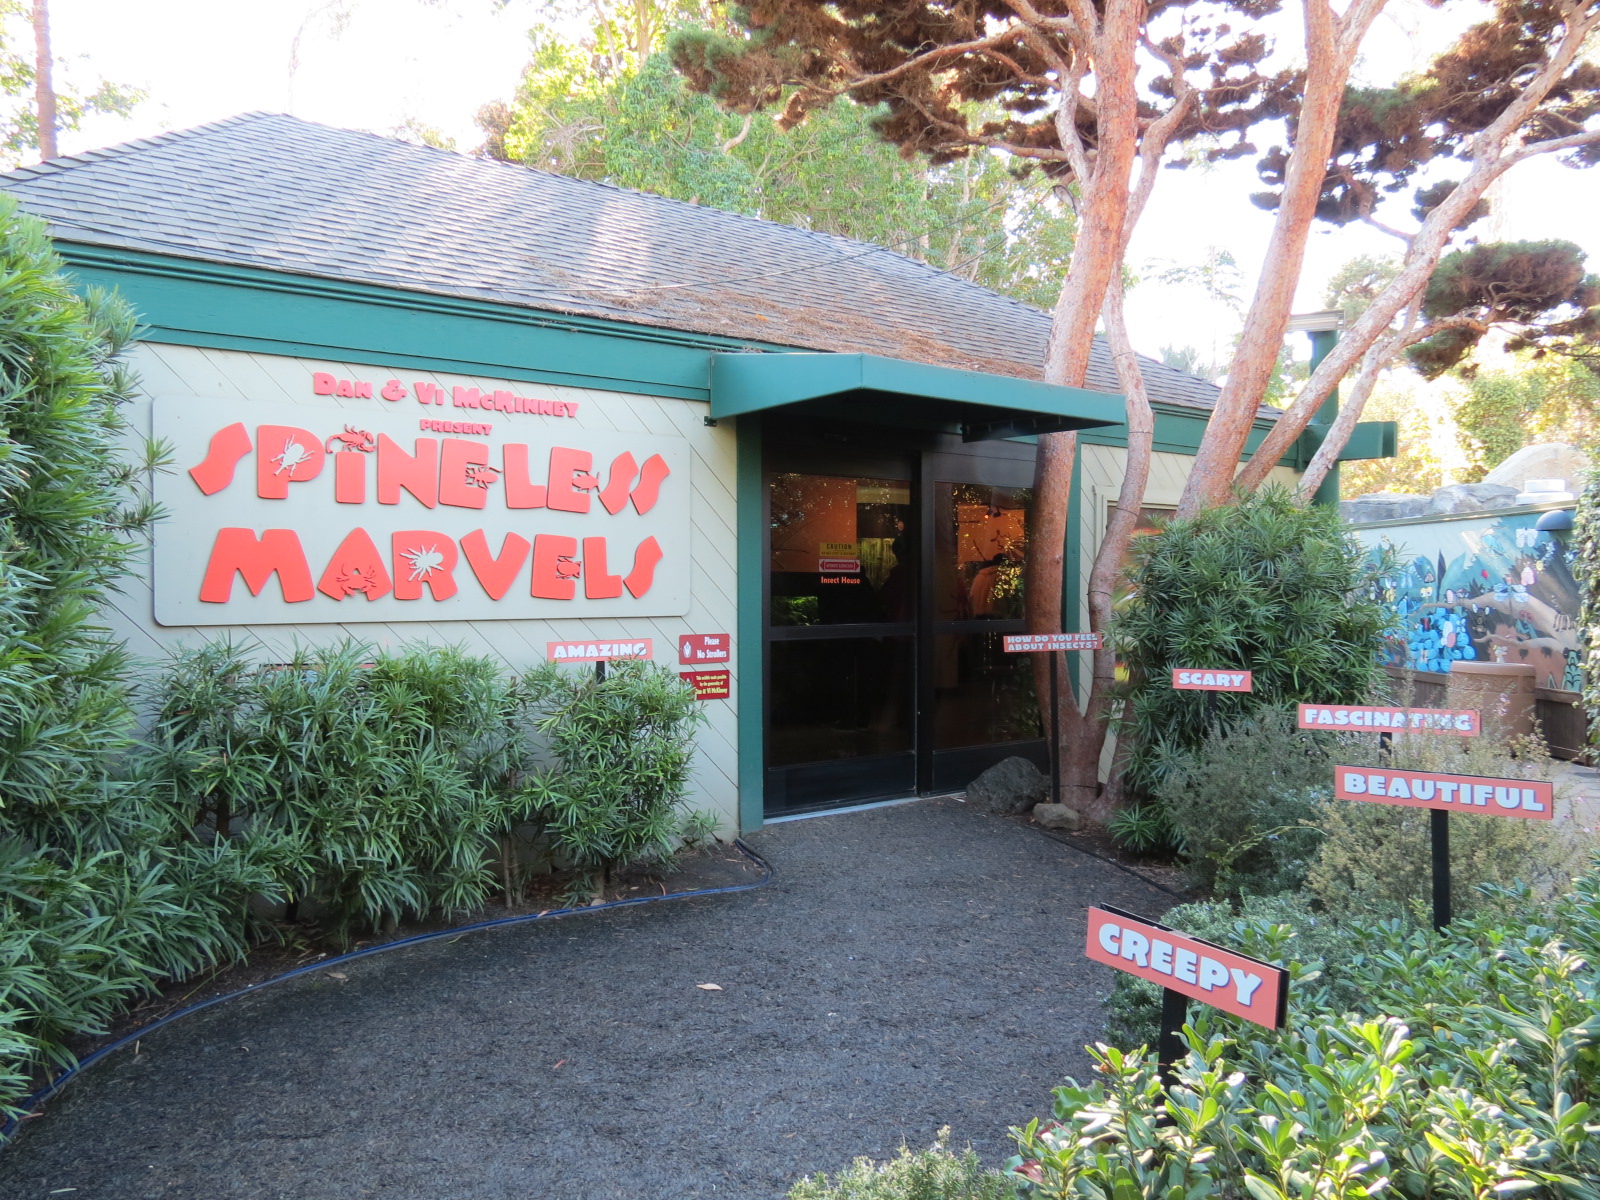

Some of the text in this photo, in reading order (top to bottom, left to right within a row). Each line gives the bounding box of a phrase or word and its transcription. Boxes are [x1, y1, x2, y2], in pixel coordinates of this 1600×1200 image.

[313, 372, 372, 399] DAN
[381, 380, 408, 401] &
[414, 382, 444, 406] VI
[420, 418, 493, 436] PRESENT
[189, 422, 671, 516] SPINELESS
[200, 527, 664, 604] MARVELS
[820, 576, 861, 584] Insect House
[704, 636, 720, 646] Please
[1007, 633, 1098, 644] HOW DO YOU FEEL
[1008, 641, 1098, 651] ABOUT INSECTS?
[553, 642, 647, 658] AMAZING
[697, 648, 727, 659] No Strollers
[1178, 672, 1244, 687] SCARY
[1305, 708, 1473, 731] FASCINATING
[1343, 772, 1544, 812] BEAUTIFUL
[1098, 922, 1263, 1007] CREEPY
